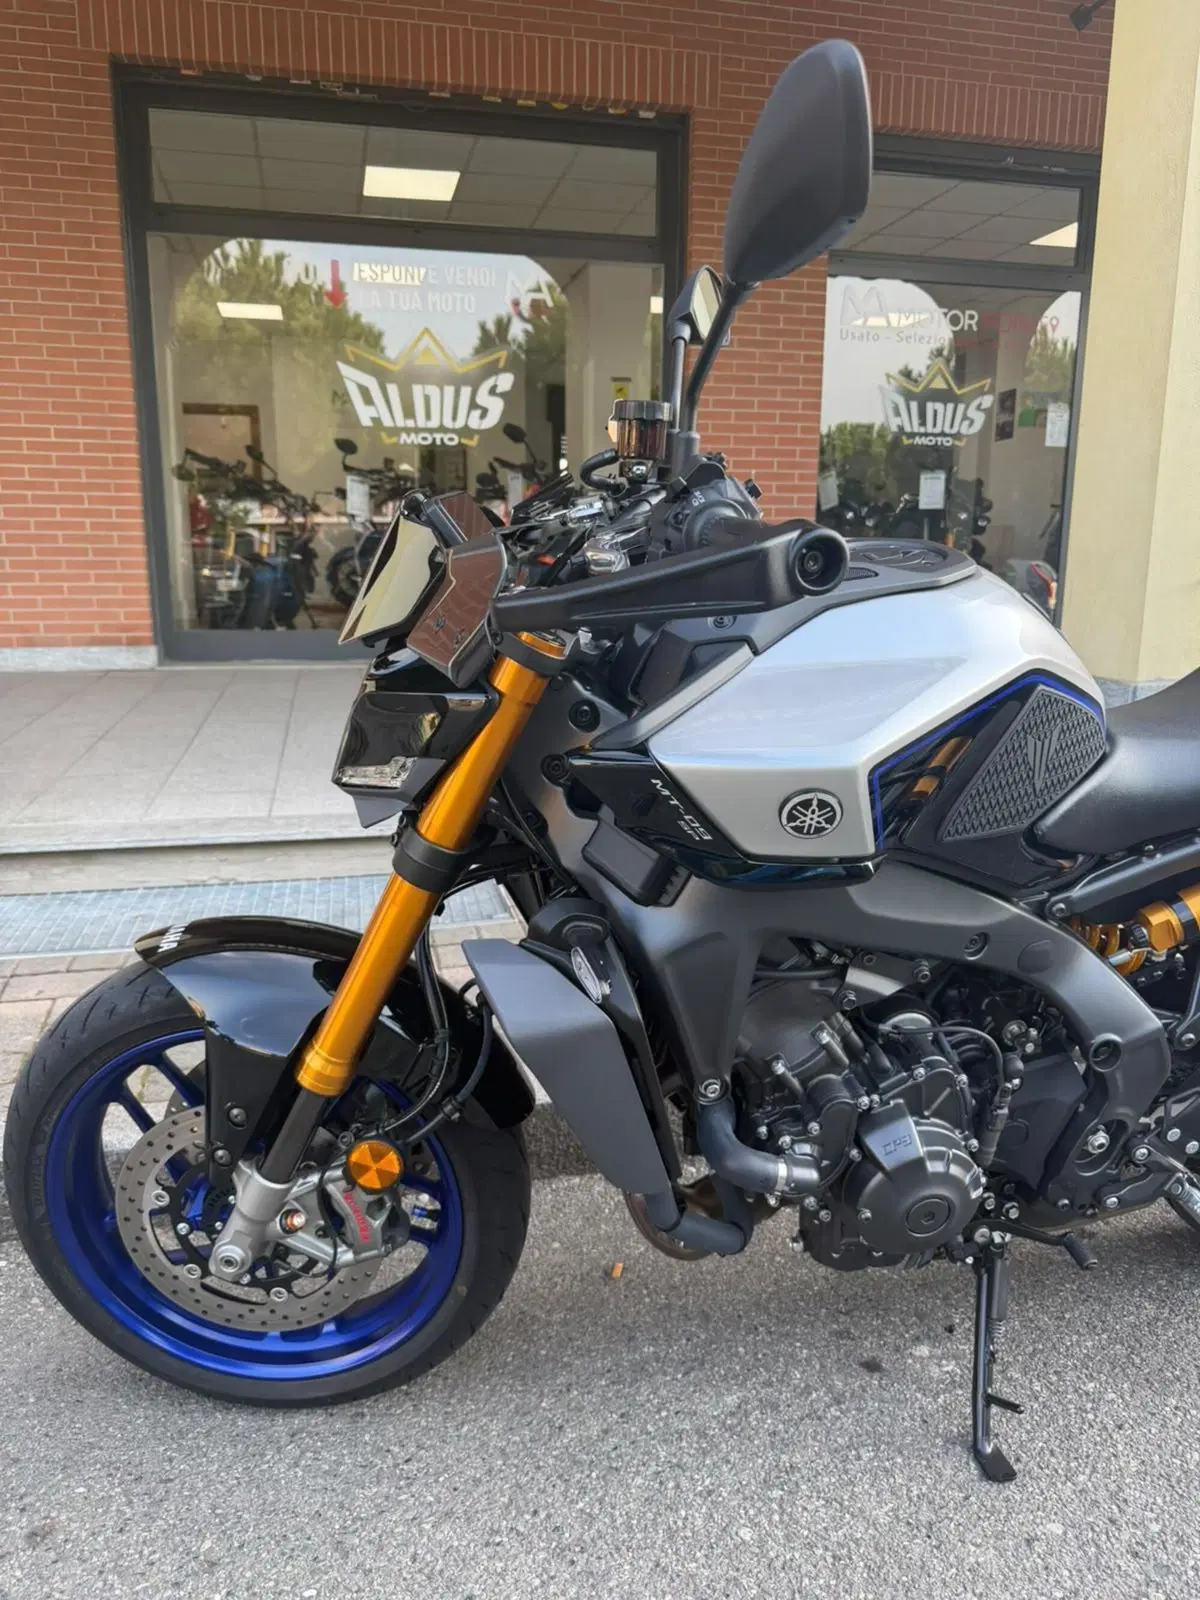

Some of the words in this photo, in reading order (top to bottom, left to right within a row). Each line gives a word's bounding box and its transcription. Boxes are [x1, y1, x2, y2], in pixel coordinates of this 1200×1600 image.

[389, 290, 423, 312] TUA
[427, 292, 477, 314] MOTO
[840, 328, 880, 342] Usato
[336, 360, 516, 430] ALDUS
[878, 384, 994, 435] ALDUS
[399, 431, 460, 446] MOTO
[914, 435, 953, 447] MOTO
[650, 779, 713, 840] MT-09
